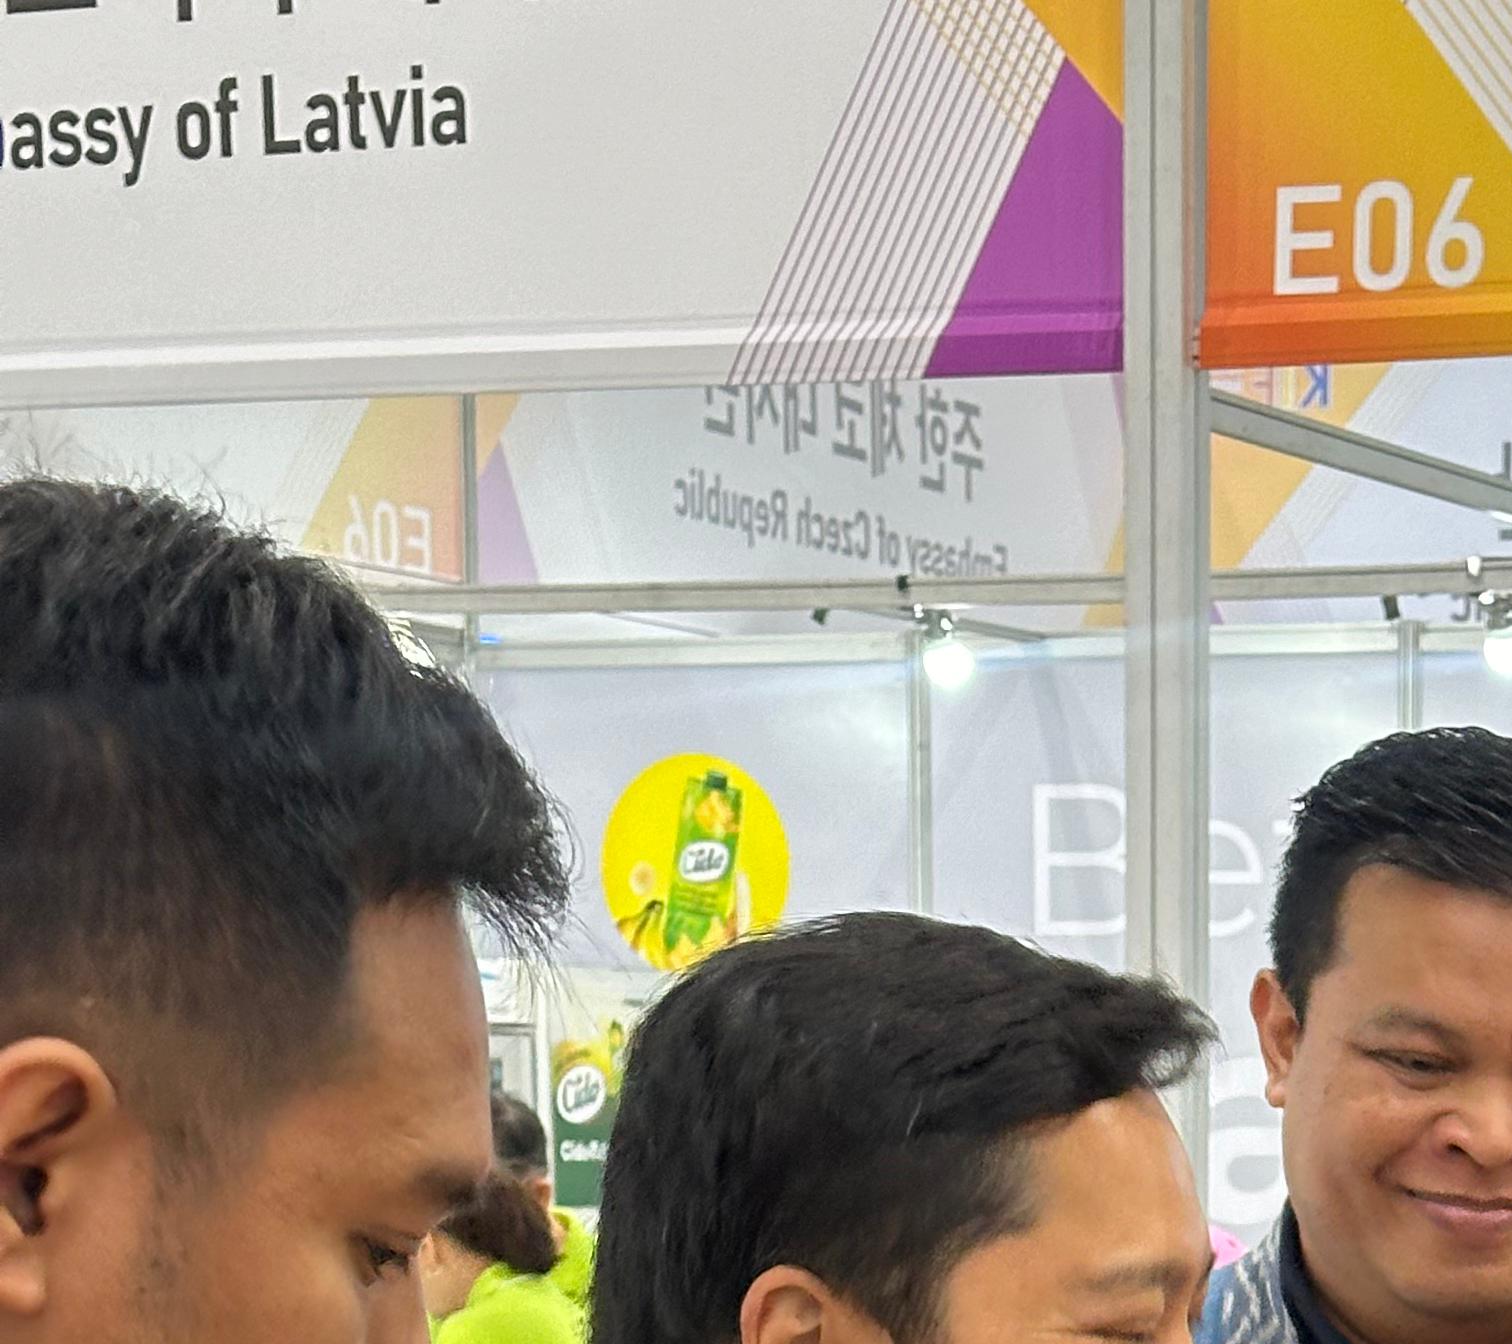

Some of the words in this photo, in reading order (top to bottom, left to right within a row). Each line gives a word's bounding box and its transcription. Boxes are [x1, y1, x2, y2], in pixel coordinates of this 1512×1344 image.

[0, 108, 153, 188] assy
[177, 77, 239, 160] of
[262, 65, 467, 156] Latvia
[1273, 175, 1485, 296] E06
